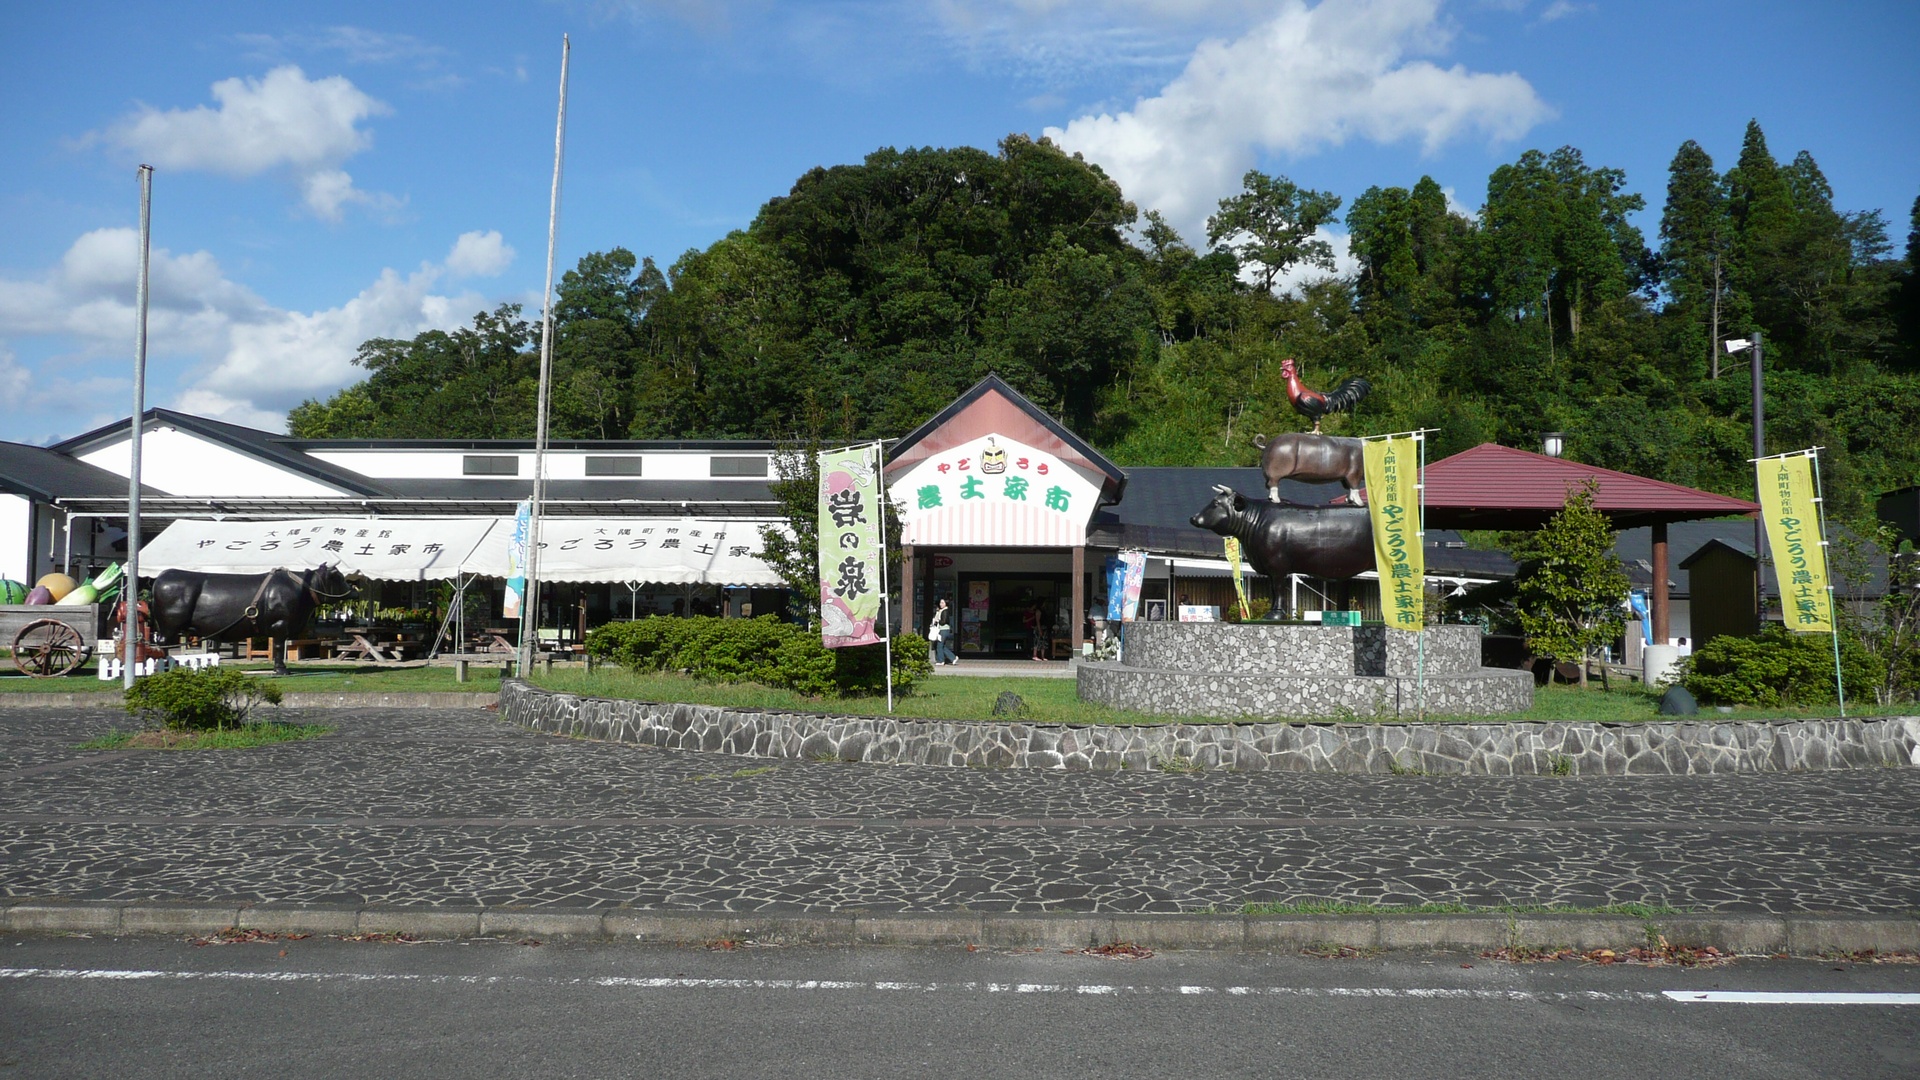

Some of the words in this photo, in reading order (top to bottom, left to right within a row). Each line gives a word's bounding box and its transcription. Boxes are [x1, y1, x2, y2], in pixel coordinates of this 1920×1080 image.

[916, 475, 1072, 512] 農土家市
[1384, 446, 1398, 502] 大隅町物産館
[1777, 464, 1794, 515] 大隅町物産館
[197, 537, 443, 556] やごろう農土家市
[267, 526, 392, 539] 大隅町物産館
[593, 527, 728, 541] 大隅町物産館
[1382, 504, 1416, 625] やごろう農土家市
[1779, 517, 1820, 625] やごろう農土家市
